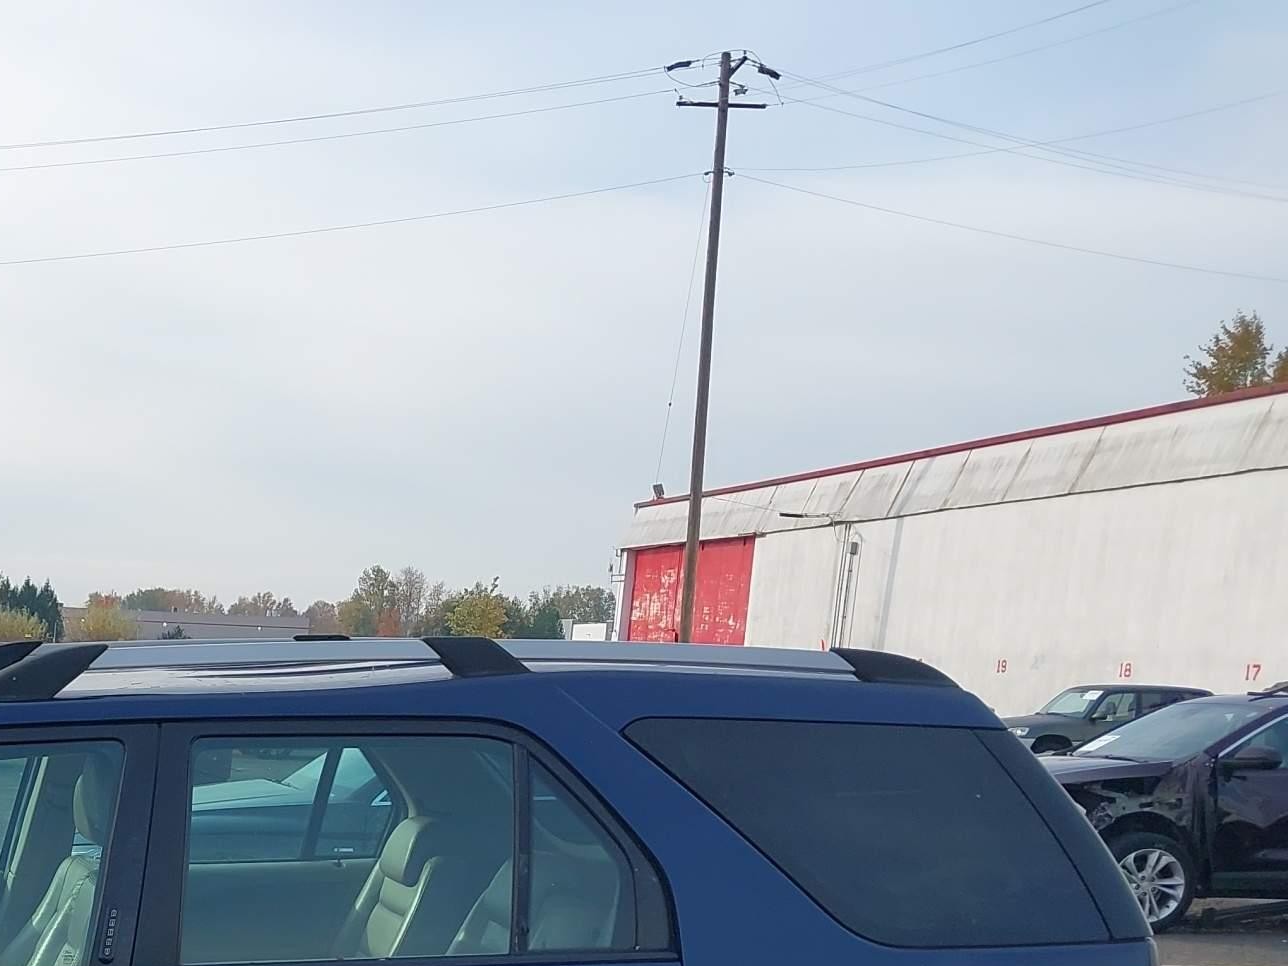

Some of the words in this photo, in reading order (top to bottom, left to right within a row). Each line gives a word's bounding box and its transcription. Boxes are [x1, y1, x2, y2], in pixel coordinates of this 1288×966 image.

[996, 659, 1007, 673] 19
[1118, 663, 1132, 677] 18
[1244, 664, 1262, 681] 17
